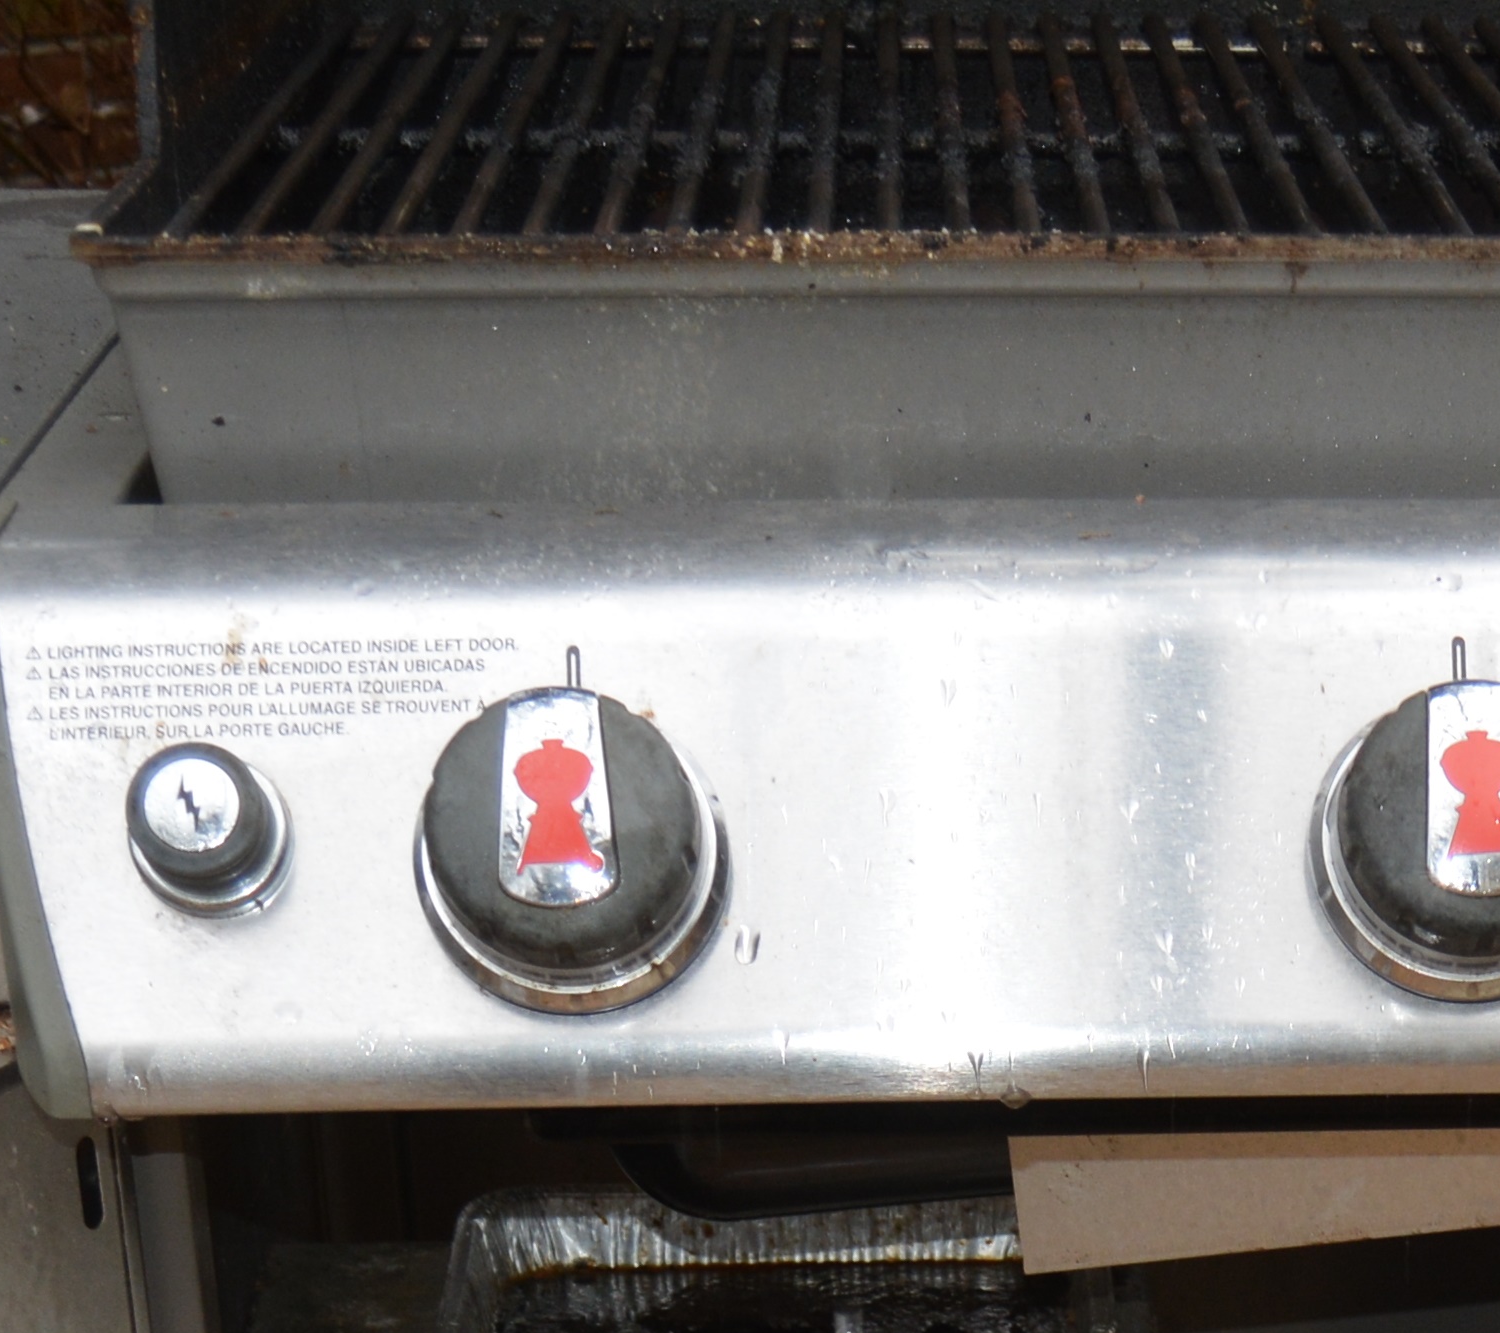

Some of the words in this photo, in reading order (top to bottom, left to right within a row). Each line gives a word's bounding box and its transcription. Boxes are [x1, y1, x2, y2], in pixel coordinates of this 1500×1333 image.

[48, 646, 122, 659] LIGHTING
[129, 643, 246, 657] INSTRUCTIONS
[252, 642, 282, 655] ARE
[289, 640, 361, 653] LOCATED
[368, 640, 419, 652] INSIDE
[426, 639, 463, 652] LEFT
[469, 638, 519, 651] DOOR.
[49, 666, 80, 679] LAS
[85, 663, 215, 678] INSTRUCCIONES
[222, 663, 241, 675] DE
[248, 661, 342, 675] ENCENDIDO
[348, 658, 401, 673] ESTÁN
[405, 659, 484, 672] UBICADAS
[49, 686, 69, 699] EN
[76, 686, 95, 699] LA
[101, 685, 150, 698] PARTE
[158, 684, 232, 697] INTERIOR
[239, 683, 258, 695] DE
[265, 683, 284, 695] LA
[291, 681, 352, 694] PUERTA
[358, 680, 448, 694] IZQUIERDA.
[50, 707, 79, 720] LES
[85, 704, 202, 718] INSTRUCTIONS
[209, 704, 252, 716] POUR
[259, 702, 357, 716] L'ALLUMAGE
[361, 701, 380, 714] SE
[387, 700, 470, 713] TROUVENT
[156, 725, 186, 739] SUR
[195, 724, 213, 737] LA
[220, 723, 273, 737] PORTE
[279, 722, 349, 736] GAUCHE.
